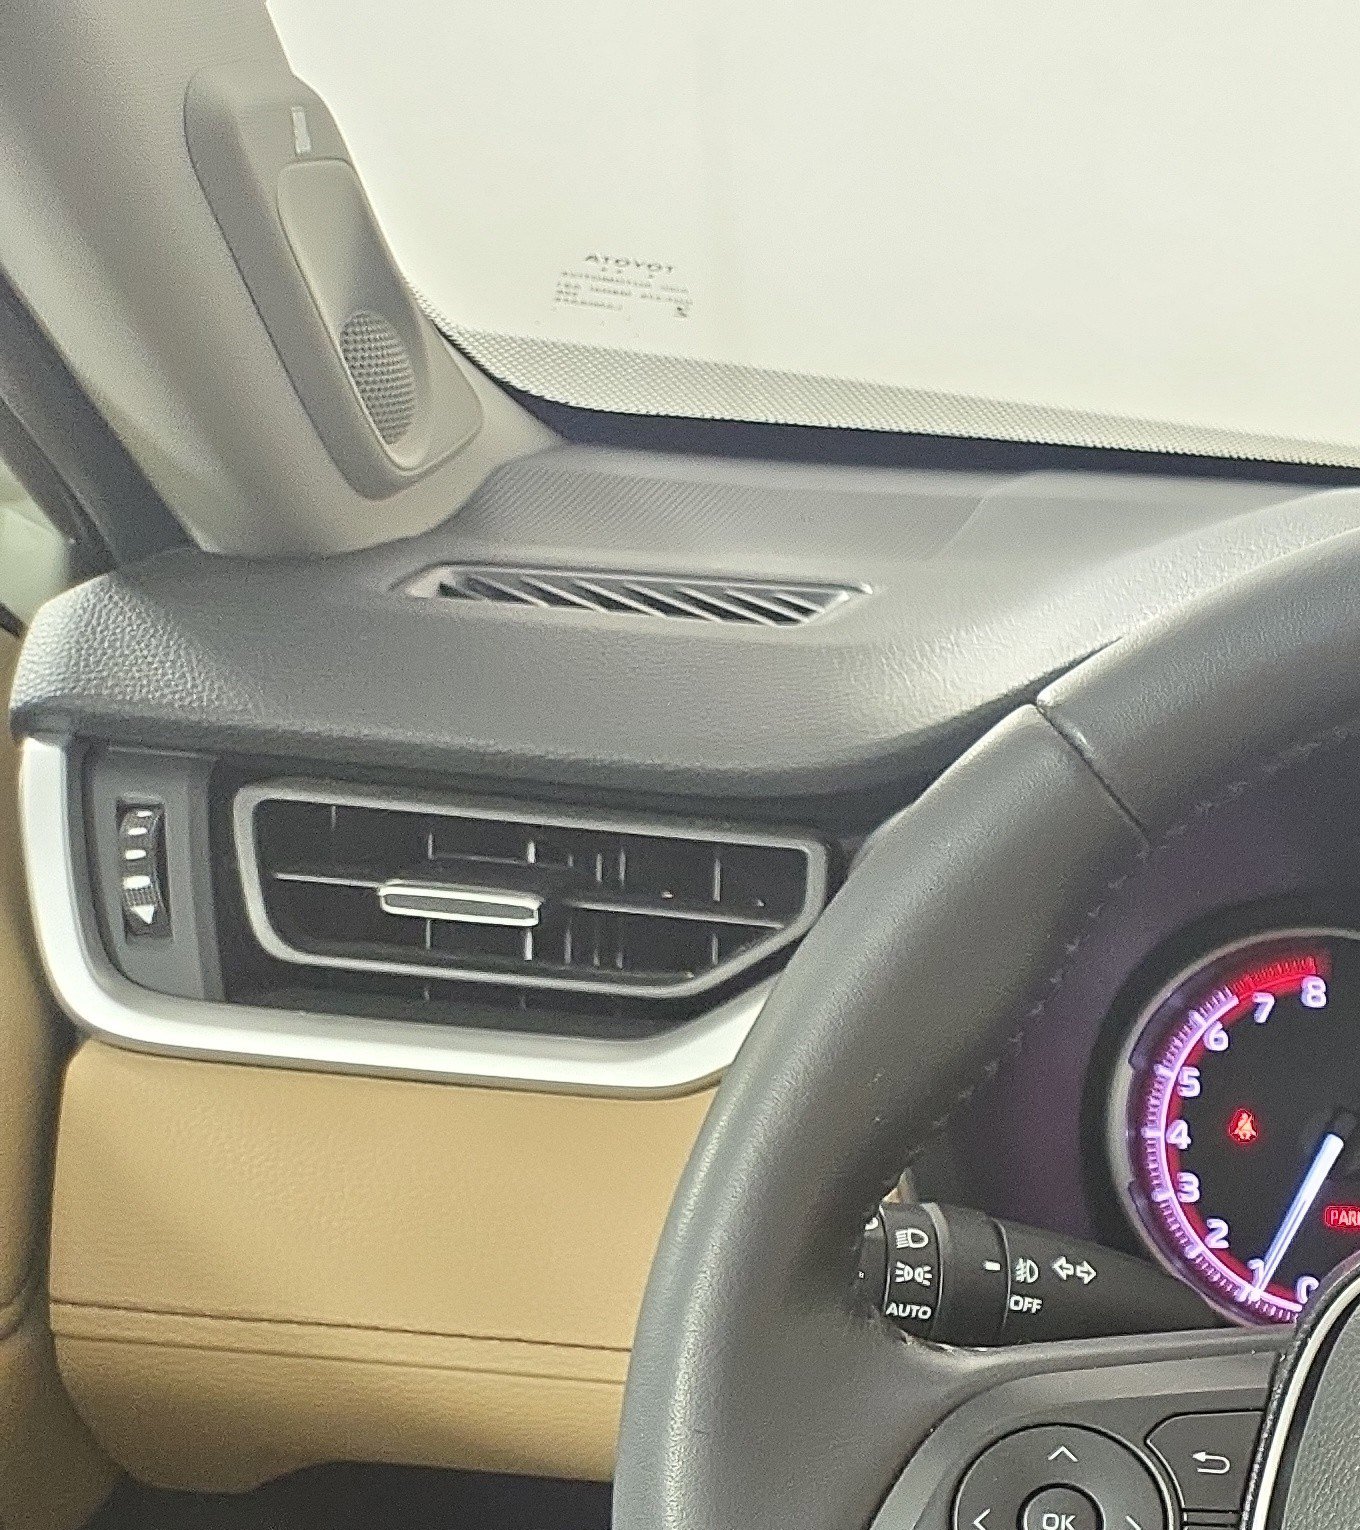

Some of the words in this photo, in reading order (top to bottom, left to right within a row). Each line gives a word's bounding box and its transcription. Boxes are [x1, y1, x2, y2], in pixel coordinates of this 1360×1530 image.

[1252, 991, 1275, 1023] 7
[1301, 975, 1327, 1009] 8
[1203, 1021, 1229, 1051] 6
[1177, 1066, 1201, 1098] 5
[1166, 1119, 1192, 1149] 4
[1176, 1172, 1200, 1203] 3
[1204, 1218, 1230, 1249] 2
[886, 1302, 932, 1320] AUTO
[1009, 1295, 1043, 1314] OFF
